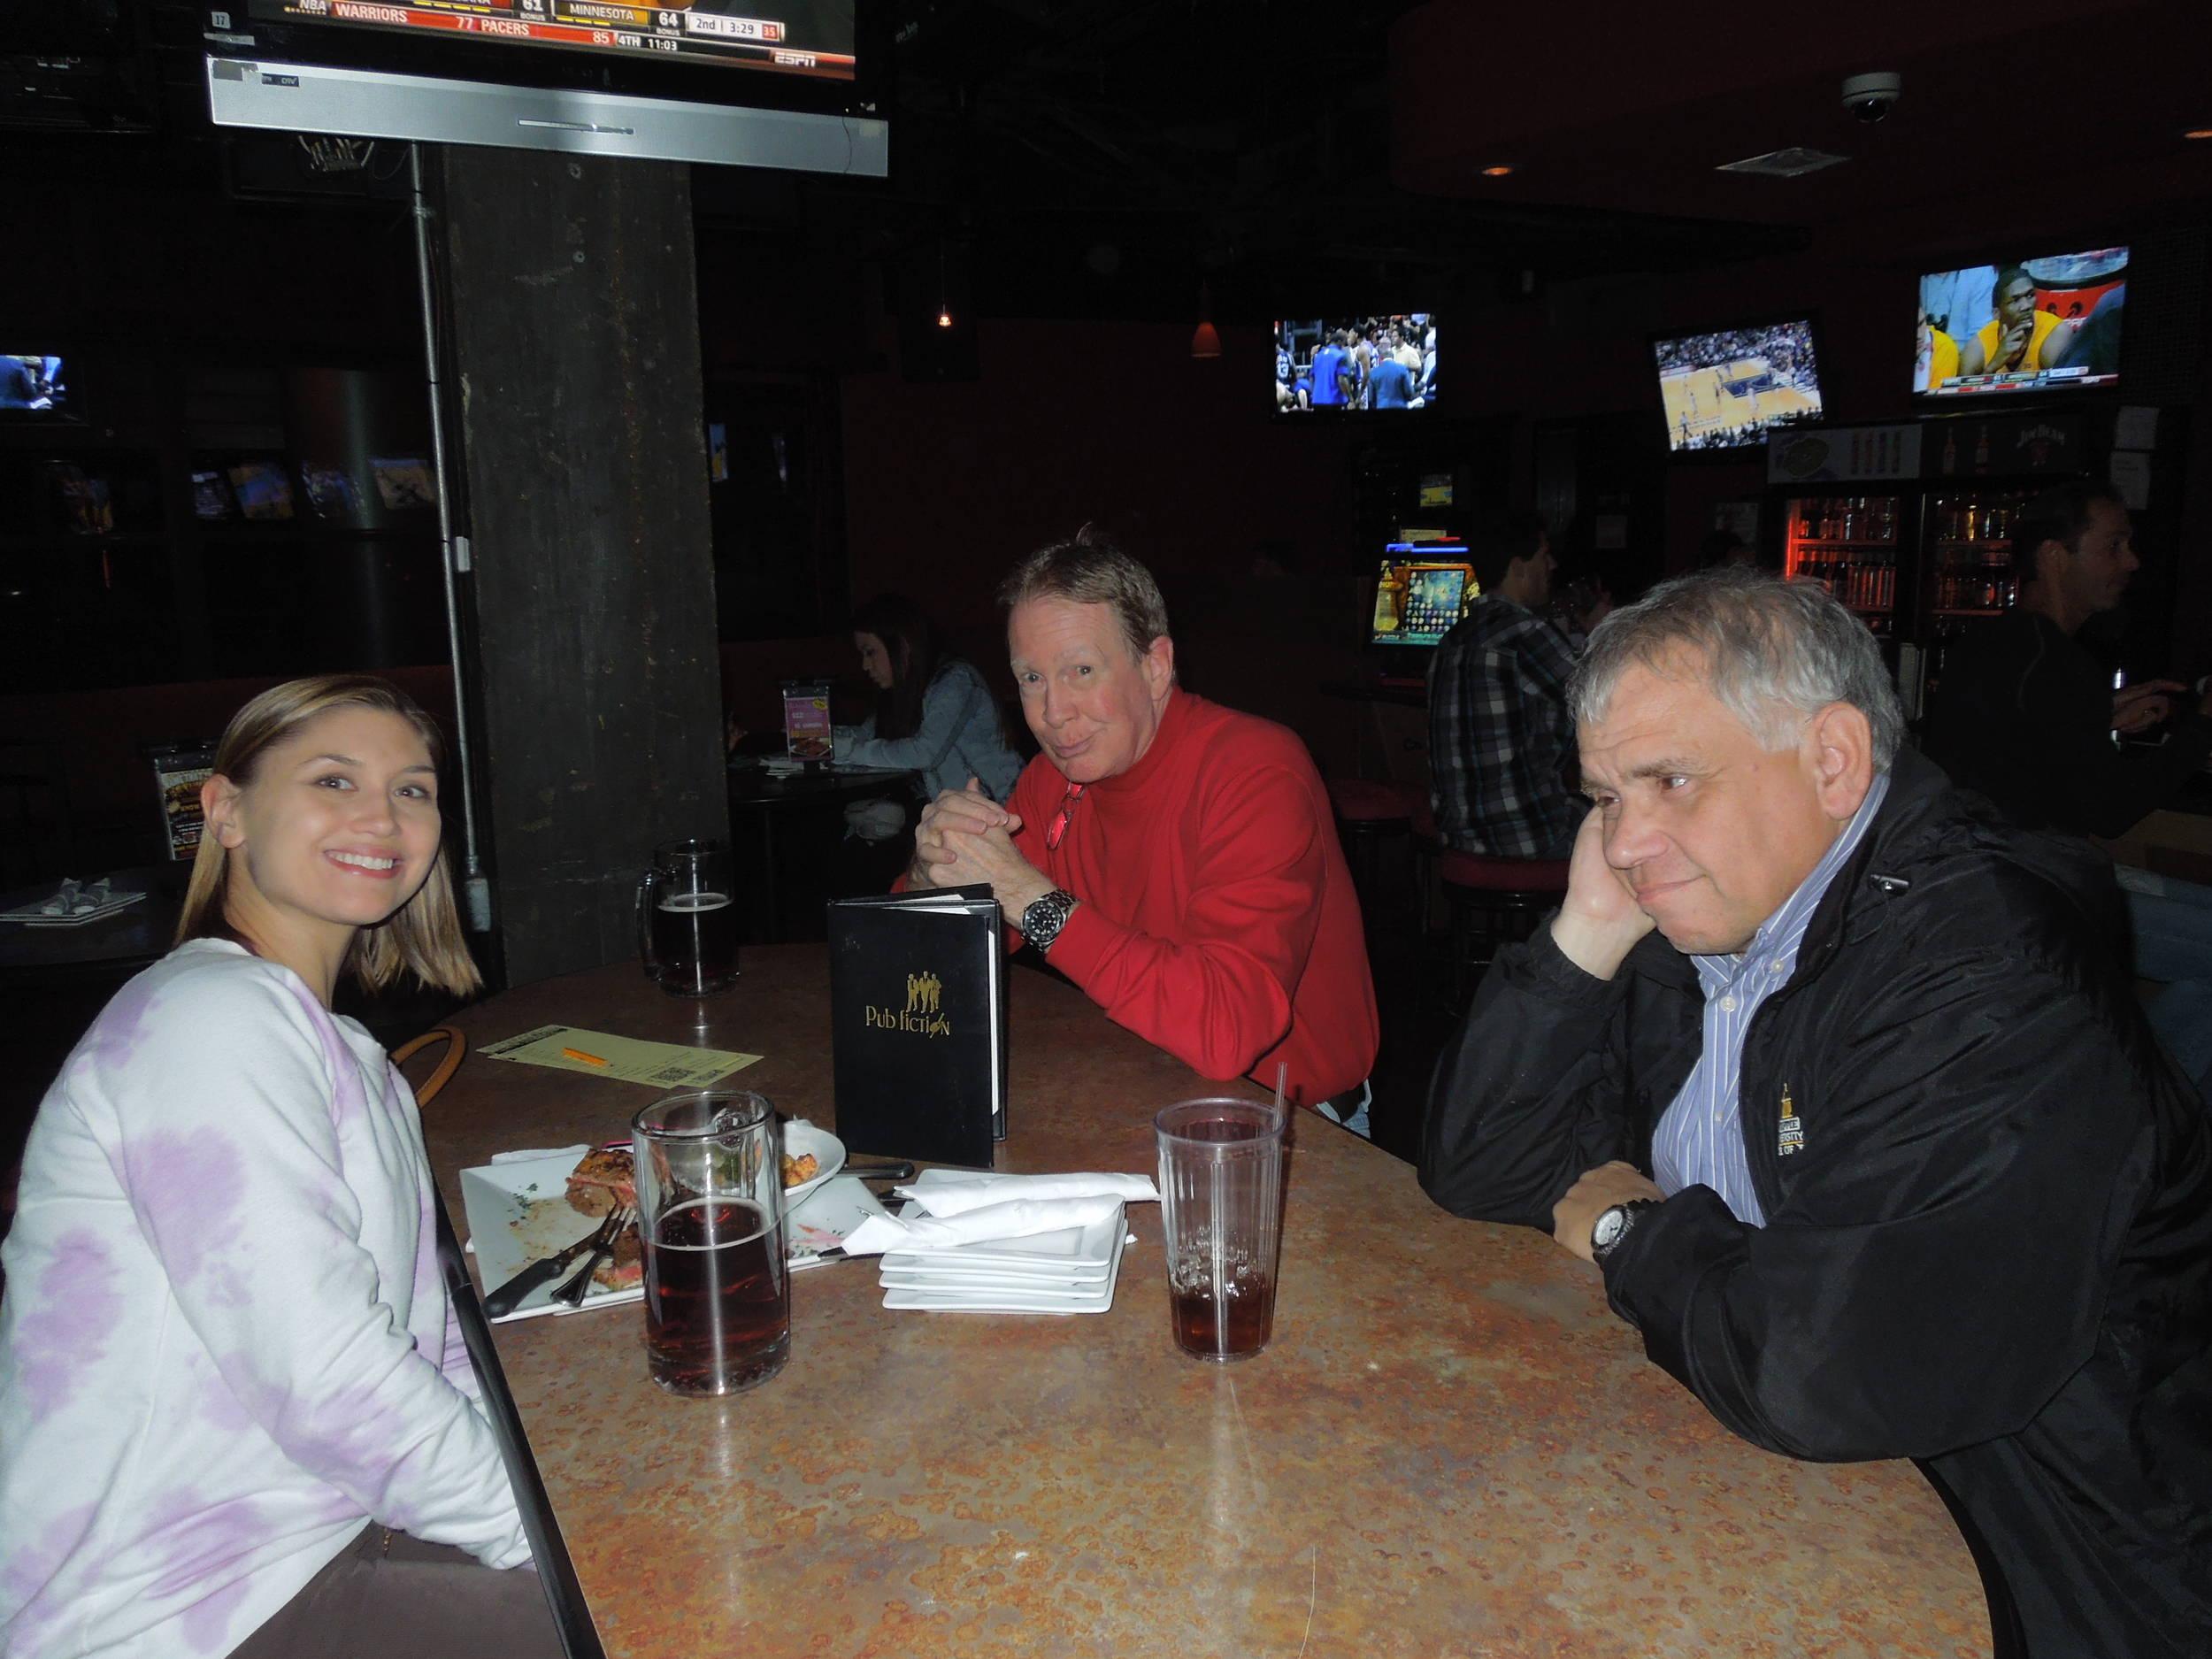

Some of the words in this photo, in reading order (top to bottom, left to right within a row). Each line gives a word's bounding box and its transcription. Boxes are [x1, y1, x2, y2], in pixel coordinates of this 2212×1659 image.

[299, 0, 326, 12] NBA
[215, 15, 225, 26] 17
[334, 4, 409, 23] WARRIORS
[456, 16, 473, 29] 77
[480, 19, 530, 35] PACERS
[593, 31, 610, 43] 85
[618, 35, 641, 47] 4TH
[648, 38, 678, 50] 11:03
[523, 0, 543, 12] 61
[569, 4, 634, 21] MINNESOTA
[658, 12, 679, 27] 64
[696, 18, 715, 31] 2nd
[729, 23, 754, 35] 3:29
[774, 51, 816, 67] ESPN
[865, 1004, 896, 1029] Pub
